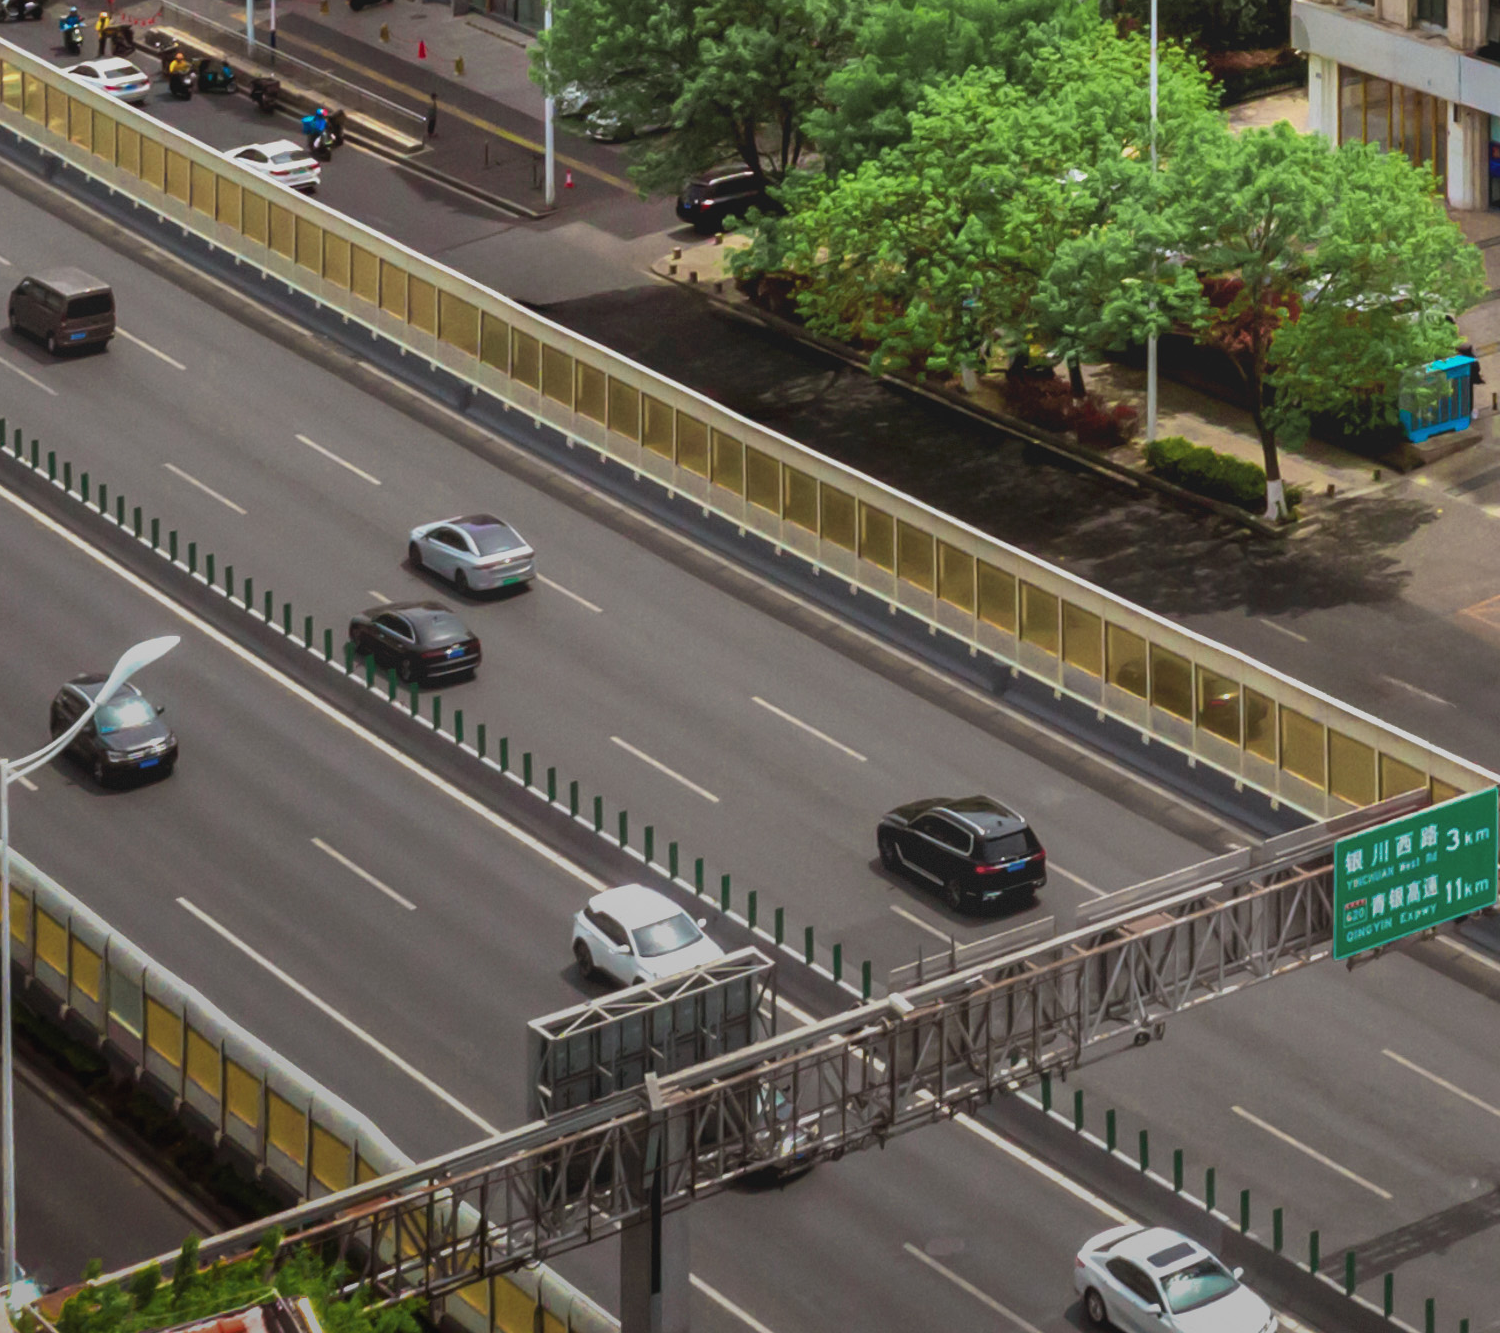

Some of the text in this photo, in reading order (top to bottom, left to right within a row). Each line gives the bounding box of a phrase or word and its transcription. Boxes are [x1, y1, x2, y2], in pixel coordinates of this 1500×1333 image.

[1345, 824, 1438, 874] 银川西路
[1371, 874, 1438, 918] 青银高速
